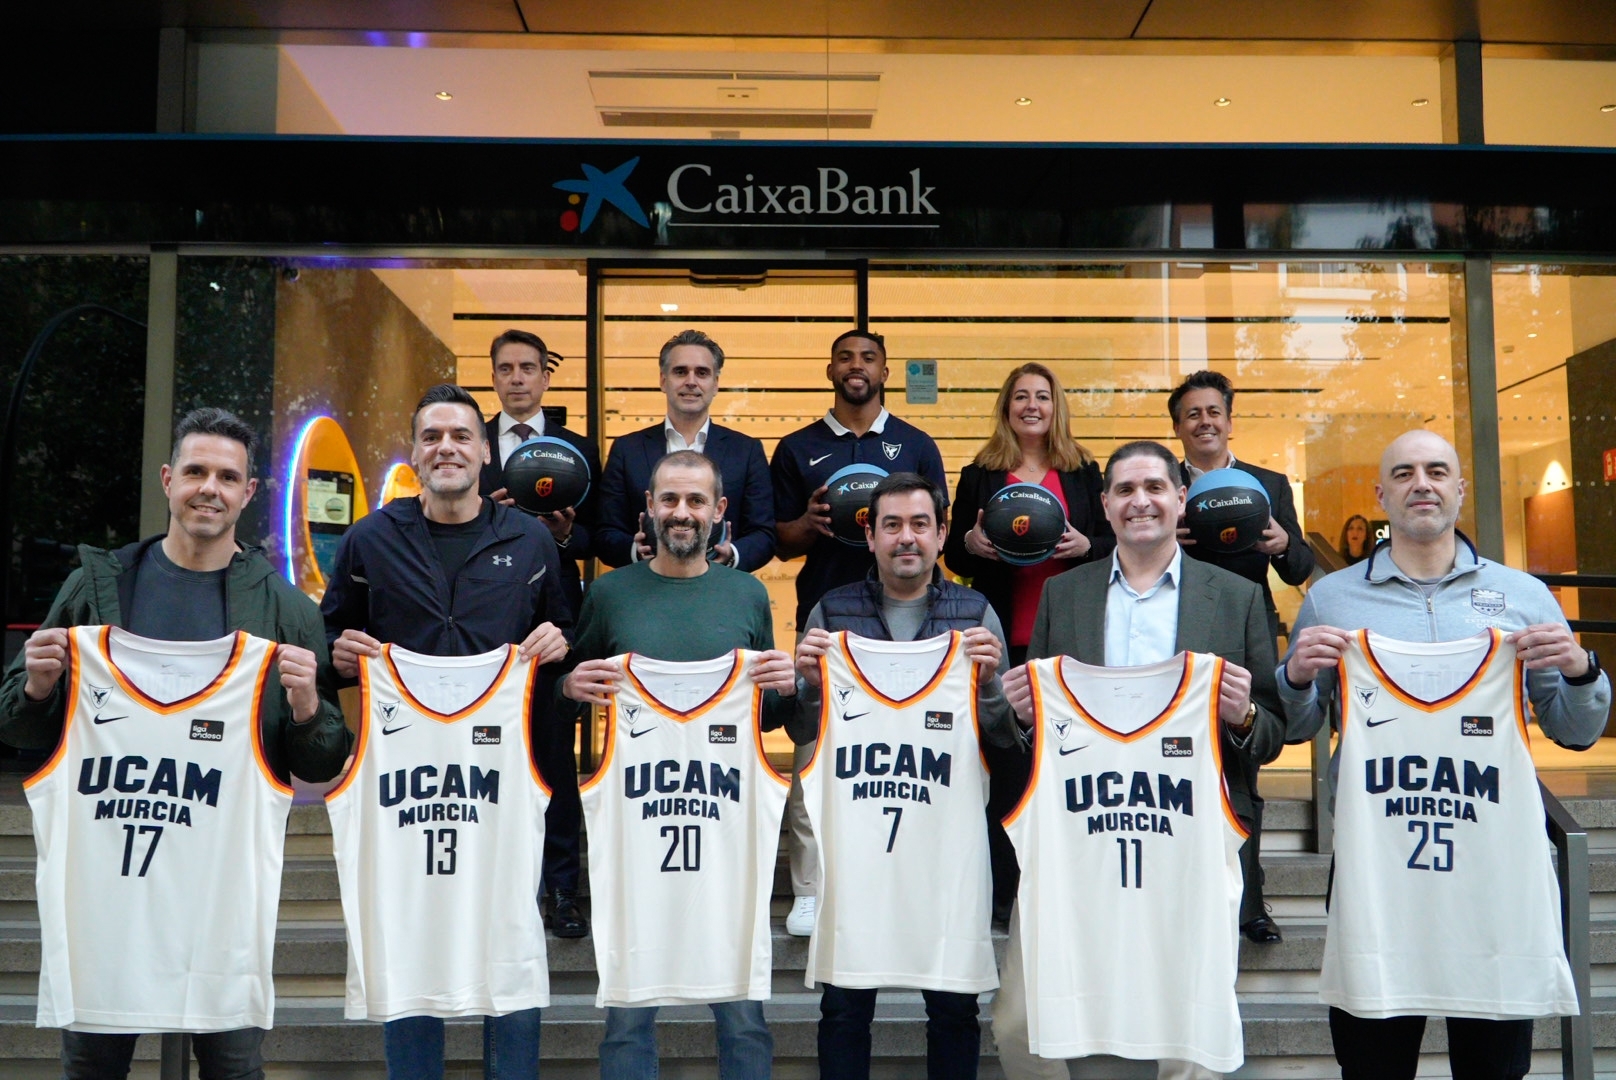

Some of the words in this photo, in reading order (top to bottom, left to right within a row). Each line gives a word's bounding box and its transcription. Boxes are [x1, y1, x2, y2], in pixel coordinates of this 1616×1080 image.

[666, 163, 940, 215] CaixaBank
[533, 449, 575, 465] CaixaBank
[850, 481, 879, 491] CaixaB
[1010, 491, 1052, 506] CaixaBank
[1208, 495, 1253, 509] CaixaBank
[191, 732, 222, 740] endesa
[192, 725, 207, 733] liga
[77, 755, 222, 808] UCAM
[379, 763, 500, 808] UCAM
[624, 759, 741, 803] UCAM
[835, 742, 952, 788] UCAM
[1365, 755, 1500, 804] UCAM
[94, 798, 192, 828] MURCIA
[642, 798, 720, 821] MURCIA
[852, 780, 932, 805] MURCIA
[1065, 771, 1194, 817] UCAM
[1385, 796, 1478, 824] MURCIA
[398, 803, 479, 828] MURCIA
[882, 806, 903, 853] 7
[1087, 812, 1174, 837] MURCIA
[120, 823, 164, 878] 17
[423, 828, 458, 876] 13
[660, 824, 701, 873] 20
[1116, 837, 1142, 889] 11
[1407, 820, 1454, 872] 25
